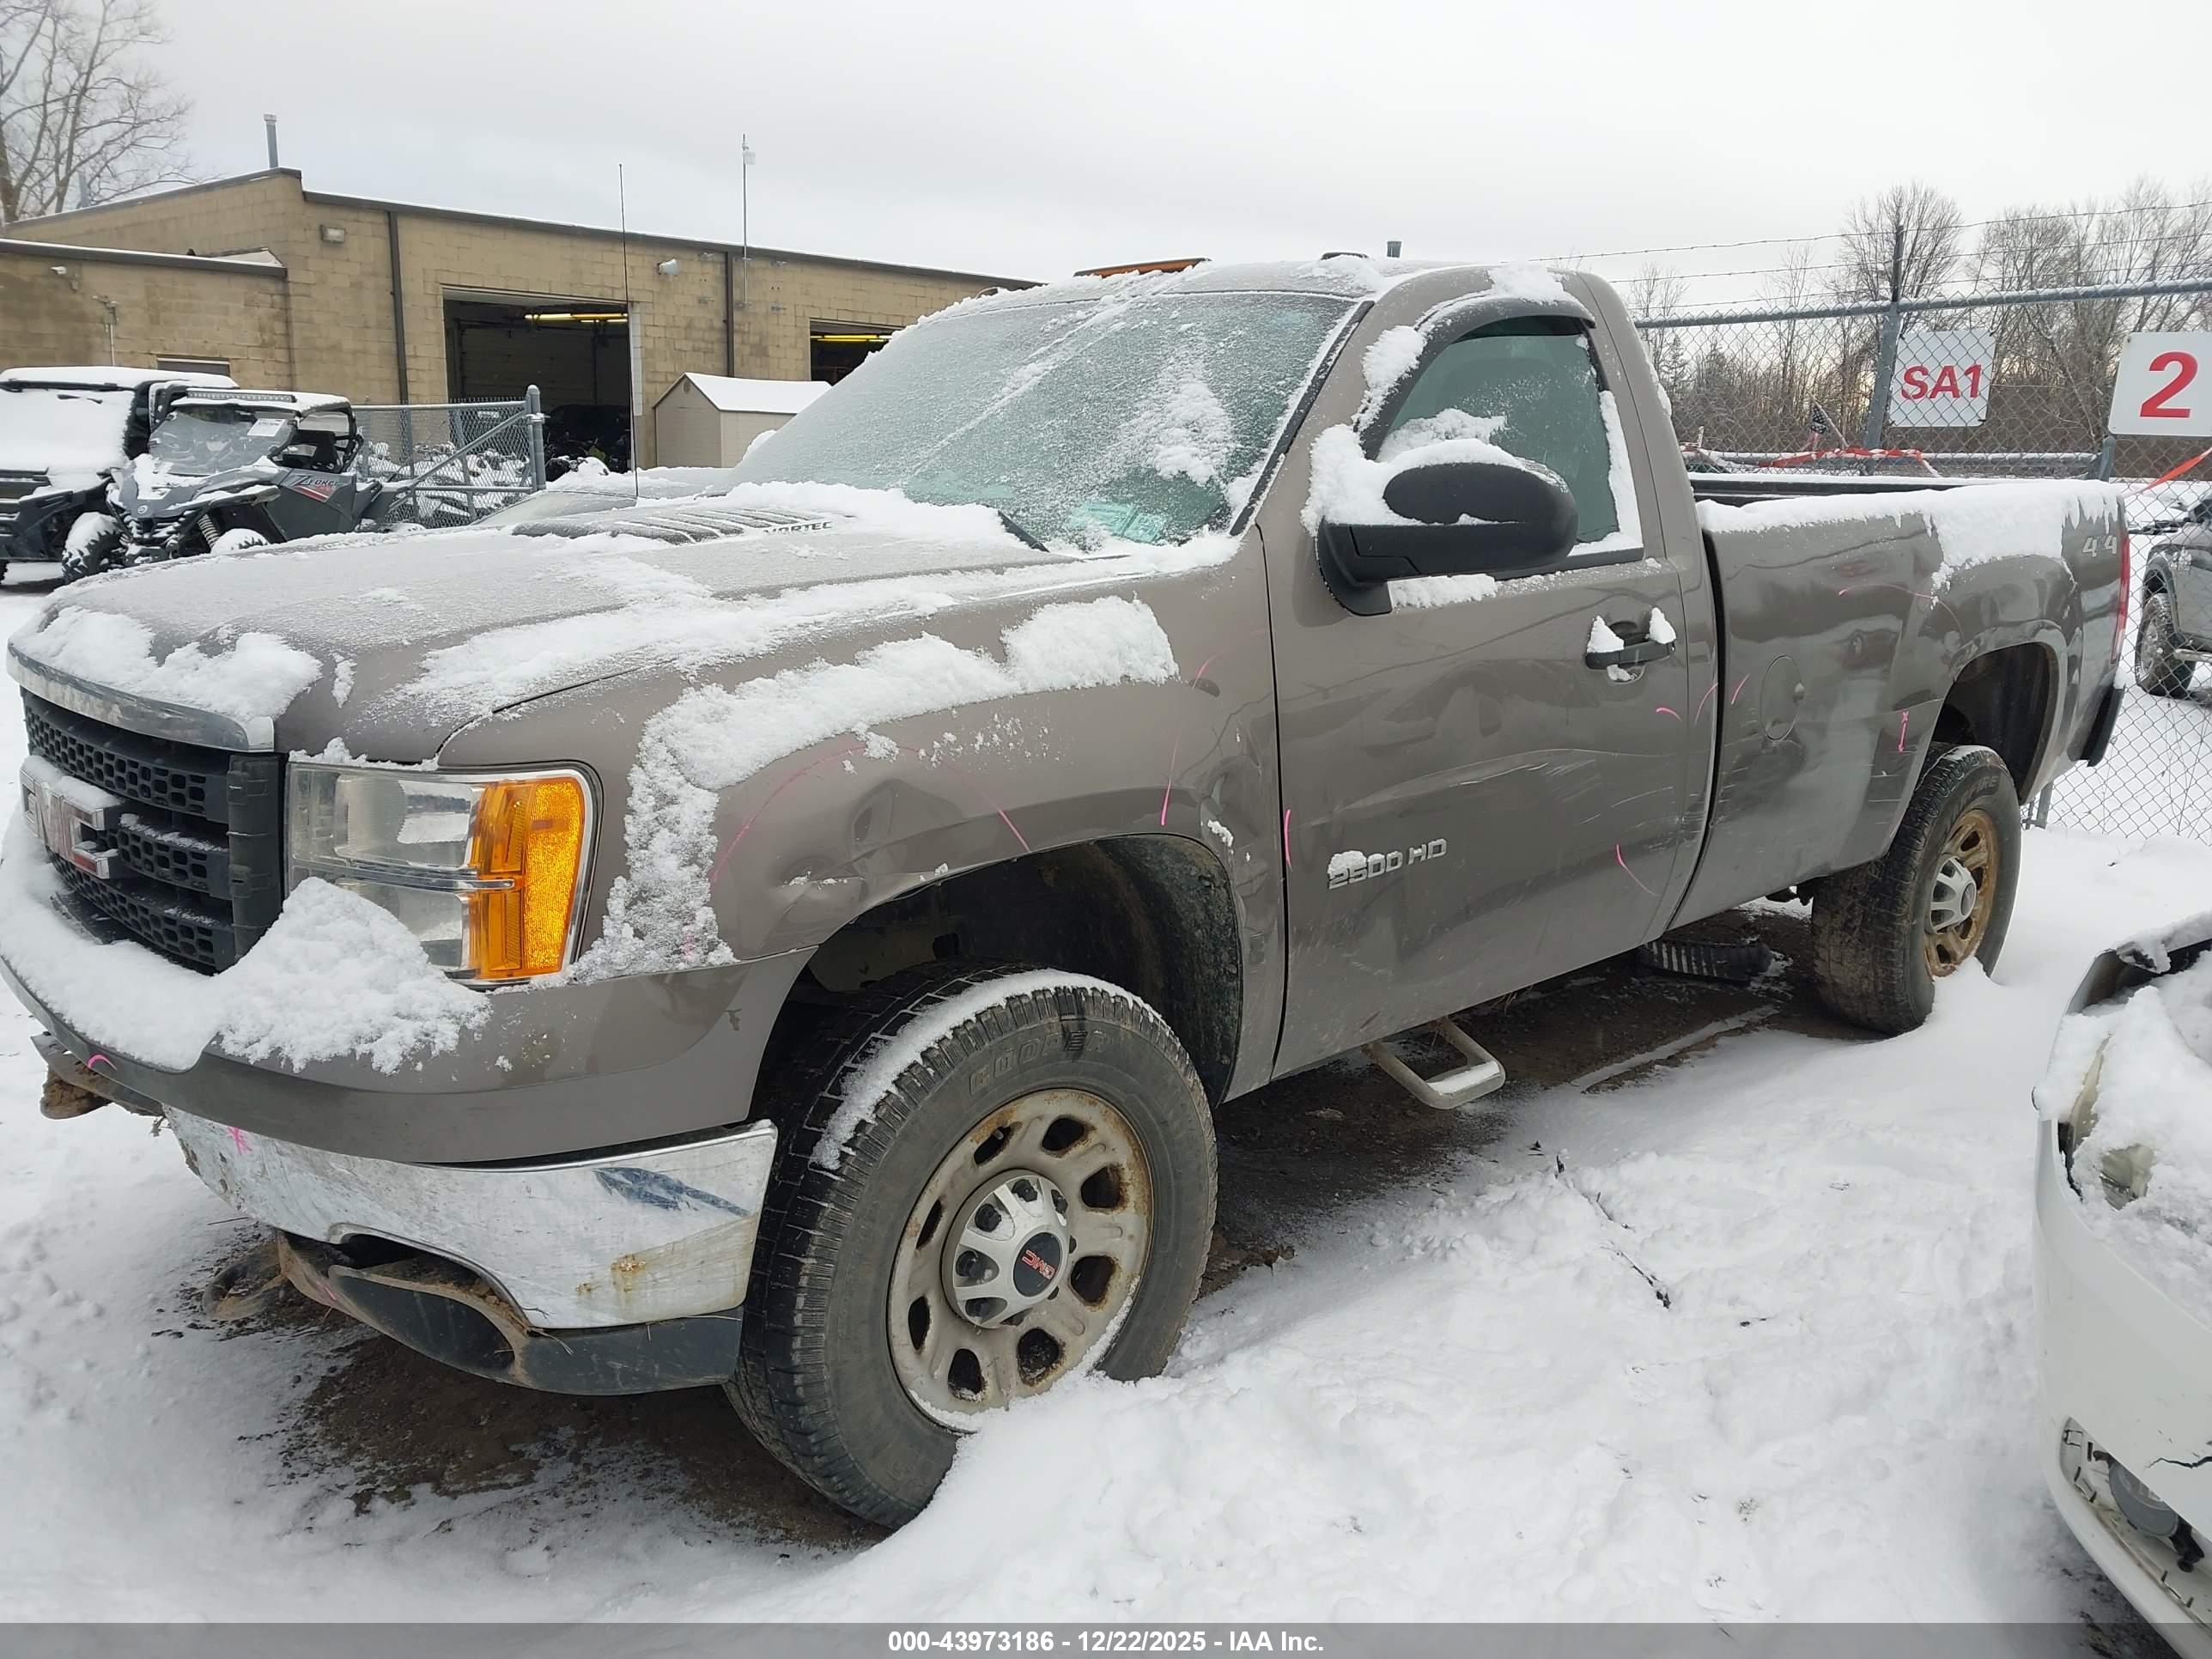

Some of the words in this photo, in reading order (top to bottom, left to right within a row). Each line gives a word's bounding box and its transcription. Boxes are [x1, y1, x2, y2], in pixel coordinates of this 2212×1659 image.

[1901, 364, 1982, 400] SA1
[2140, 350, 2198, 418] 2
[2082, 534, 2118, 557] 44
[20, 769, 110, 879] GMC
[1328, 851, 1403, 890] 2500
[1408, 838, 1447, 866] HD
[1022, 1249, 1055, 1279] GMC
